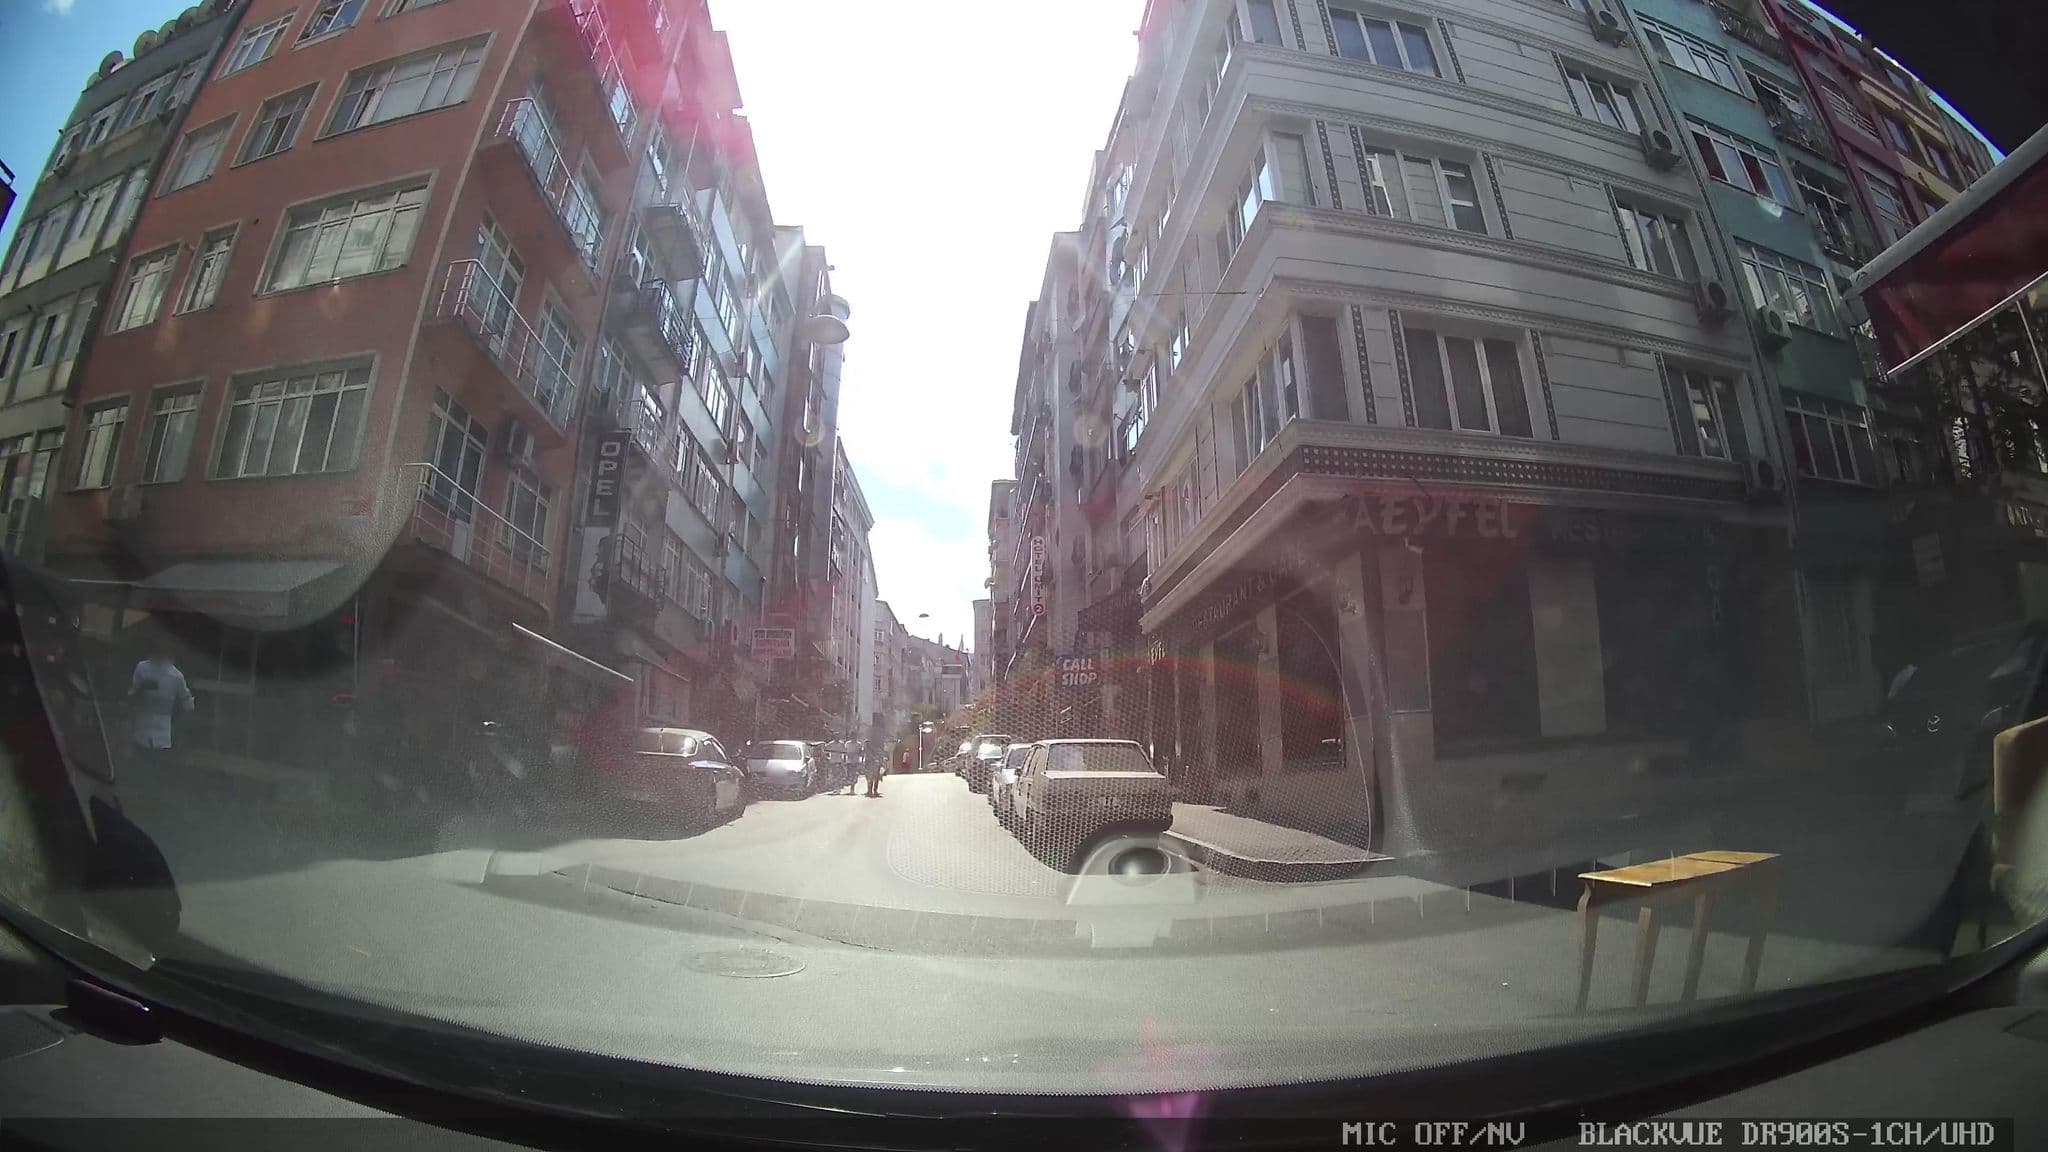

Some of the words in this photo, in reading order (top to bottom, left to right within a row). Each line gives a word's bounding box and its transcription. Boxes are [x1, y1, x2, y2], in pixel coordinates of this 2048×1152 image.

[593, 441, 621, 516] OPEL
[1033, 538, 1043, 572] HOTEL
[1062, 658, 1095, 671] CALL
[1061, 672, 1098, 687] SHOP
